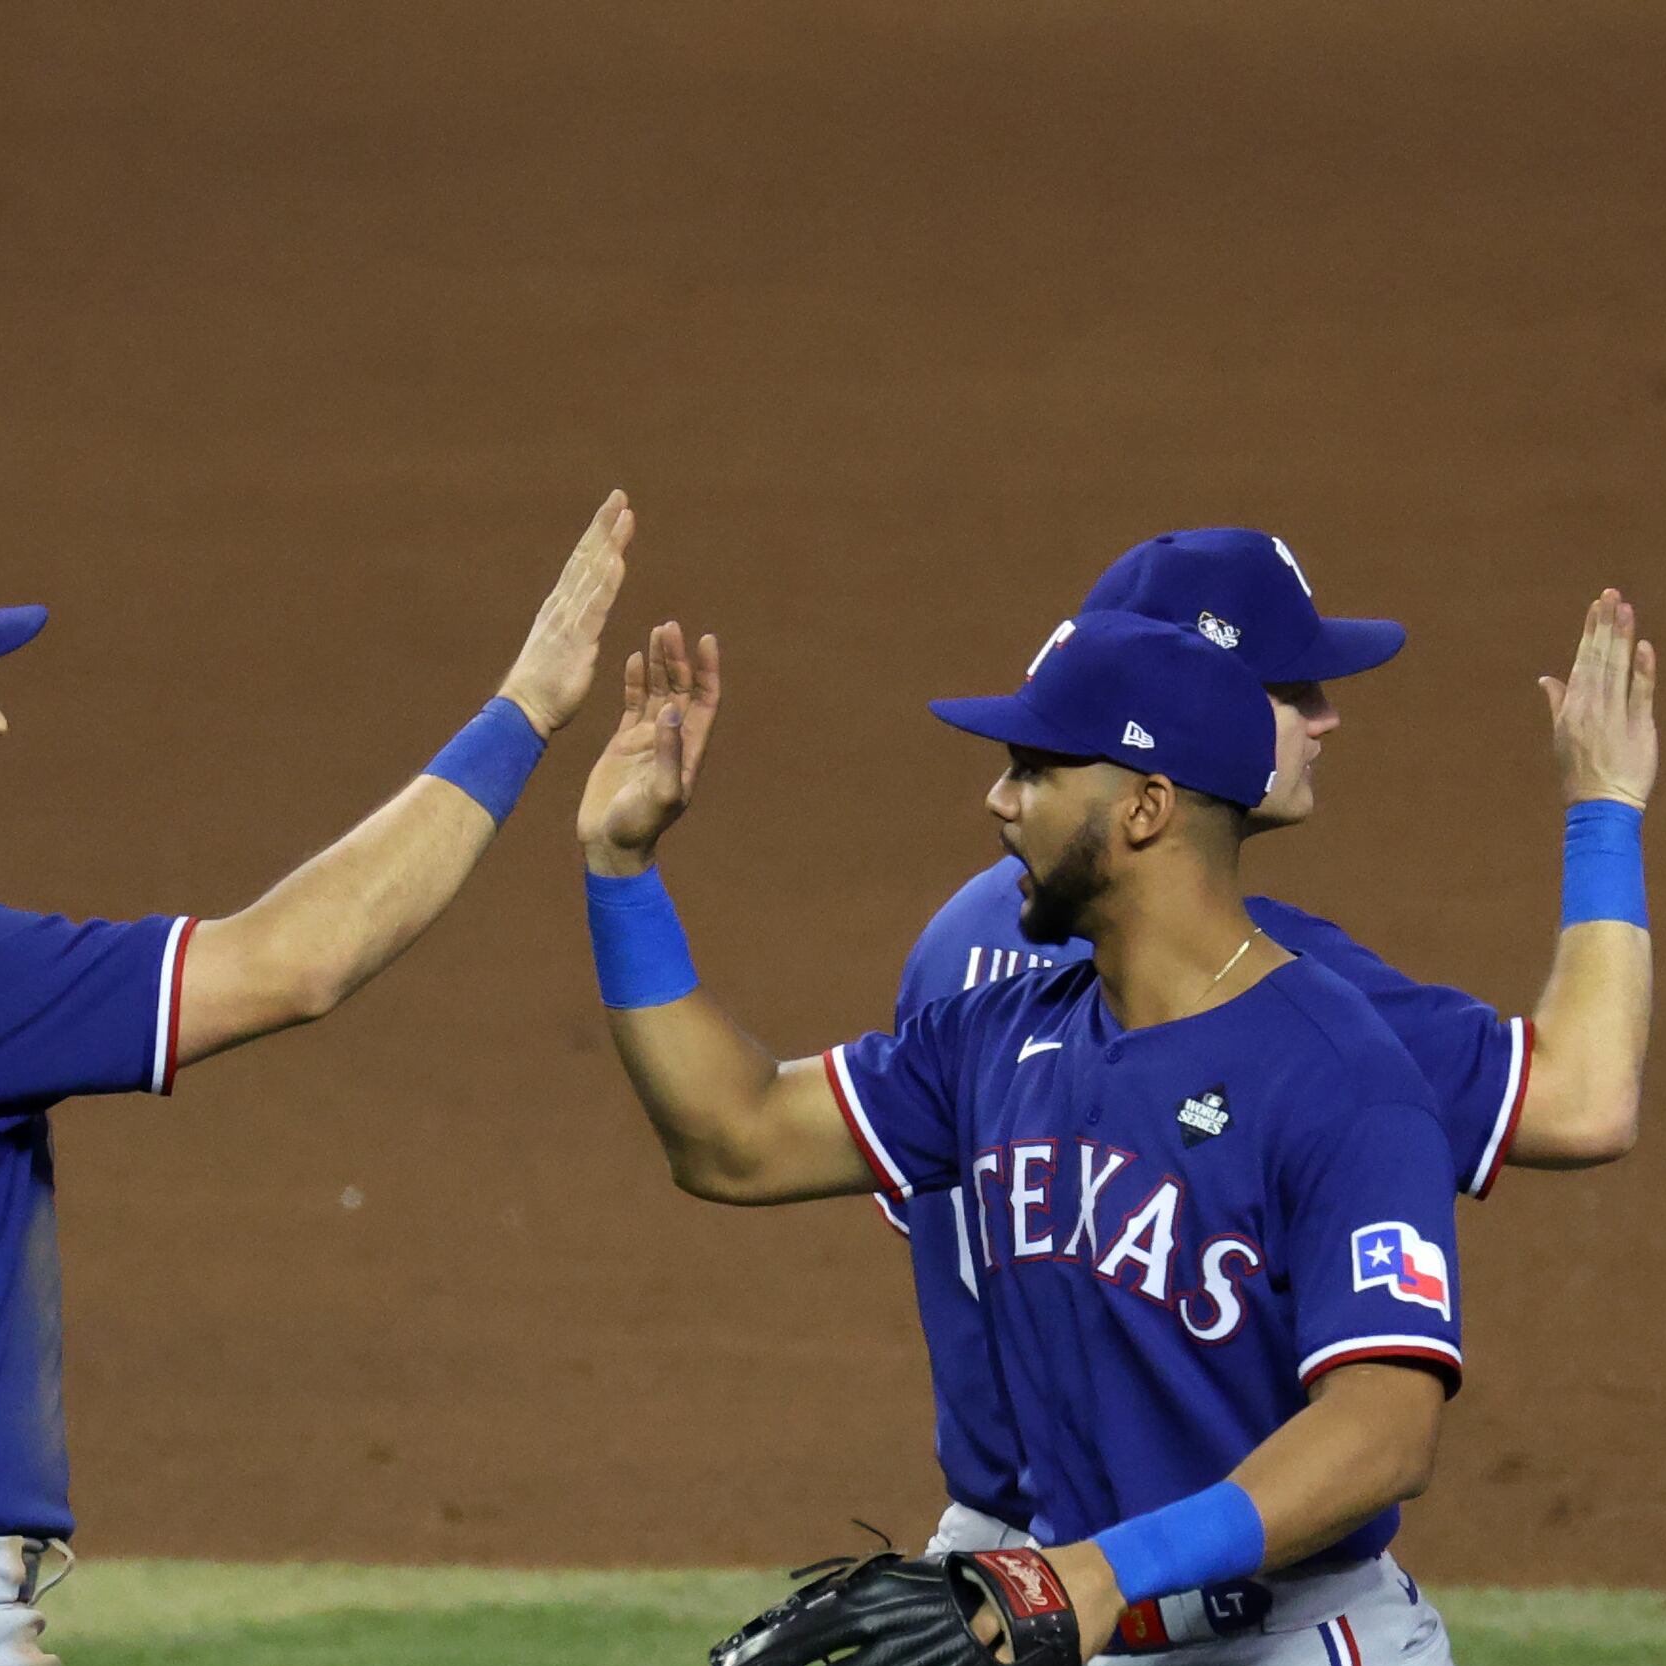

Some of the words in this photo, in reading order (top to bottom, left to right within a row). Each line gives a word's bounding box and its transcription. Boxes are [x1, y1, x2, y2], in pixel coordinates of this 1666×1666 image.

[1176, 1109, 1224, 1136] SERIES
[1184, 1098, 1229, 1124] WORLD
[1210, 1592, 1251, 1619] LT
